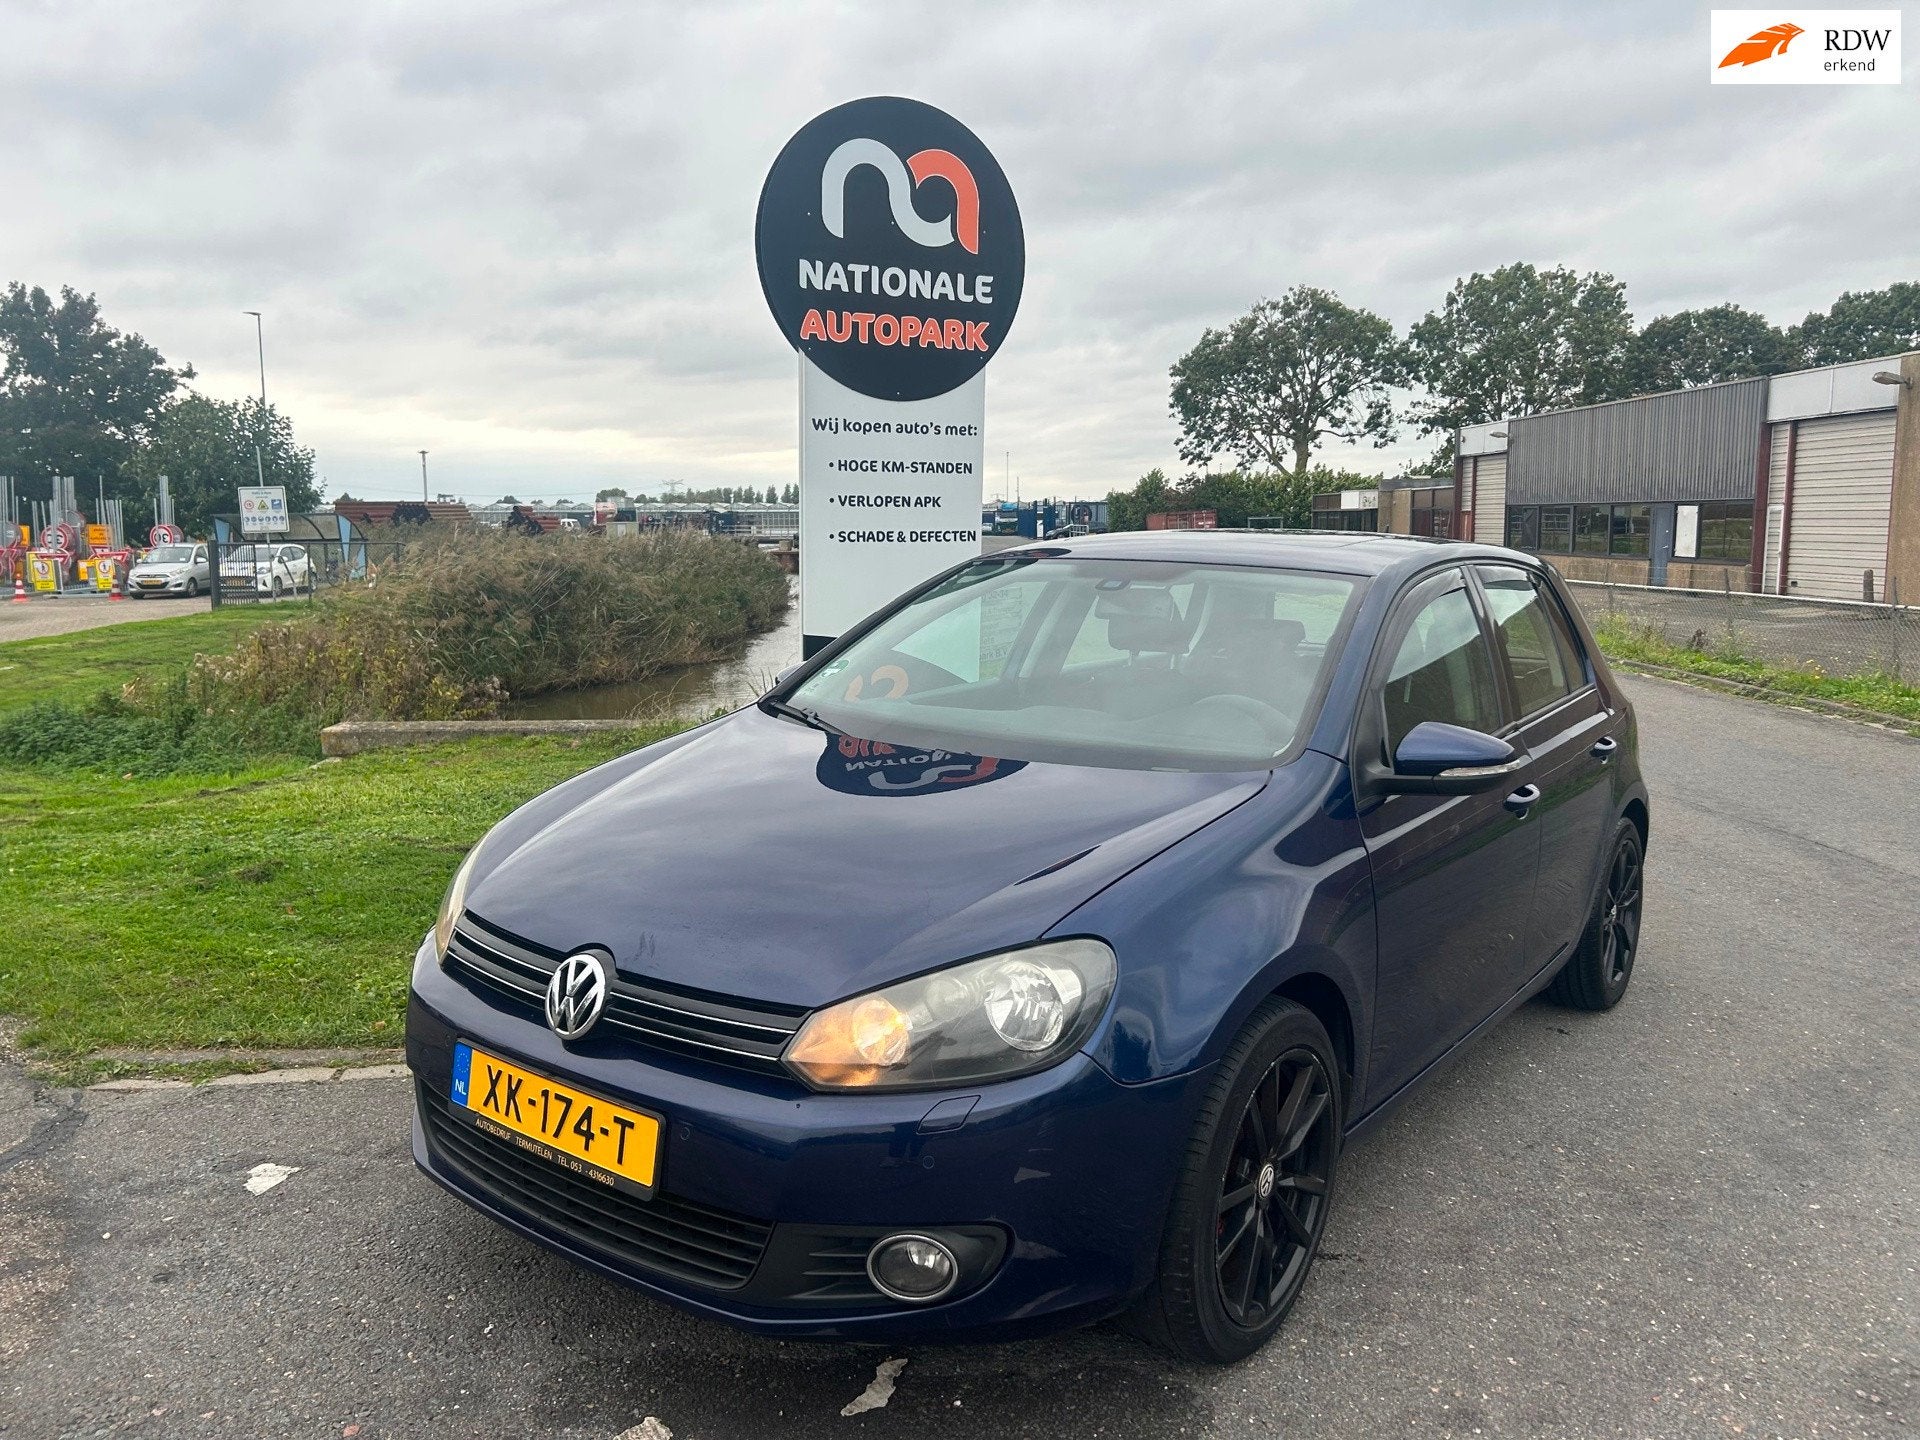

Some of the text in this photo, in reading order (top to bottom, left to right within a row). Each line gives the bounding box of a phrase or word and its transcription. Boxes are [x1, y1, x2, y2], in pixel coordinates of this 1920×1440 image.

[798, 258, 994, 304] NATIONALE
[799, 308, 990, 352] AUTOPARK
[812, 418, 978, 437] Wij kopen auto's met:
[837, 459, 973, 475] HOGE KM-STANDEN
[838, 494, 942, 508] VERLOPEN APK
[838, 530, 977, 543] SCHADE & DEFECTEN
[454, 1078, 467, 1096] NL
[482, 1064, 635, 1166] XK-174-T
